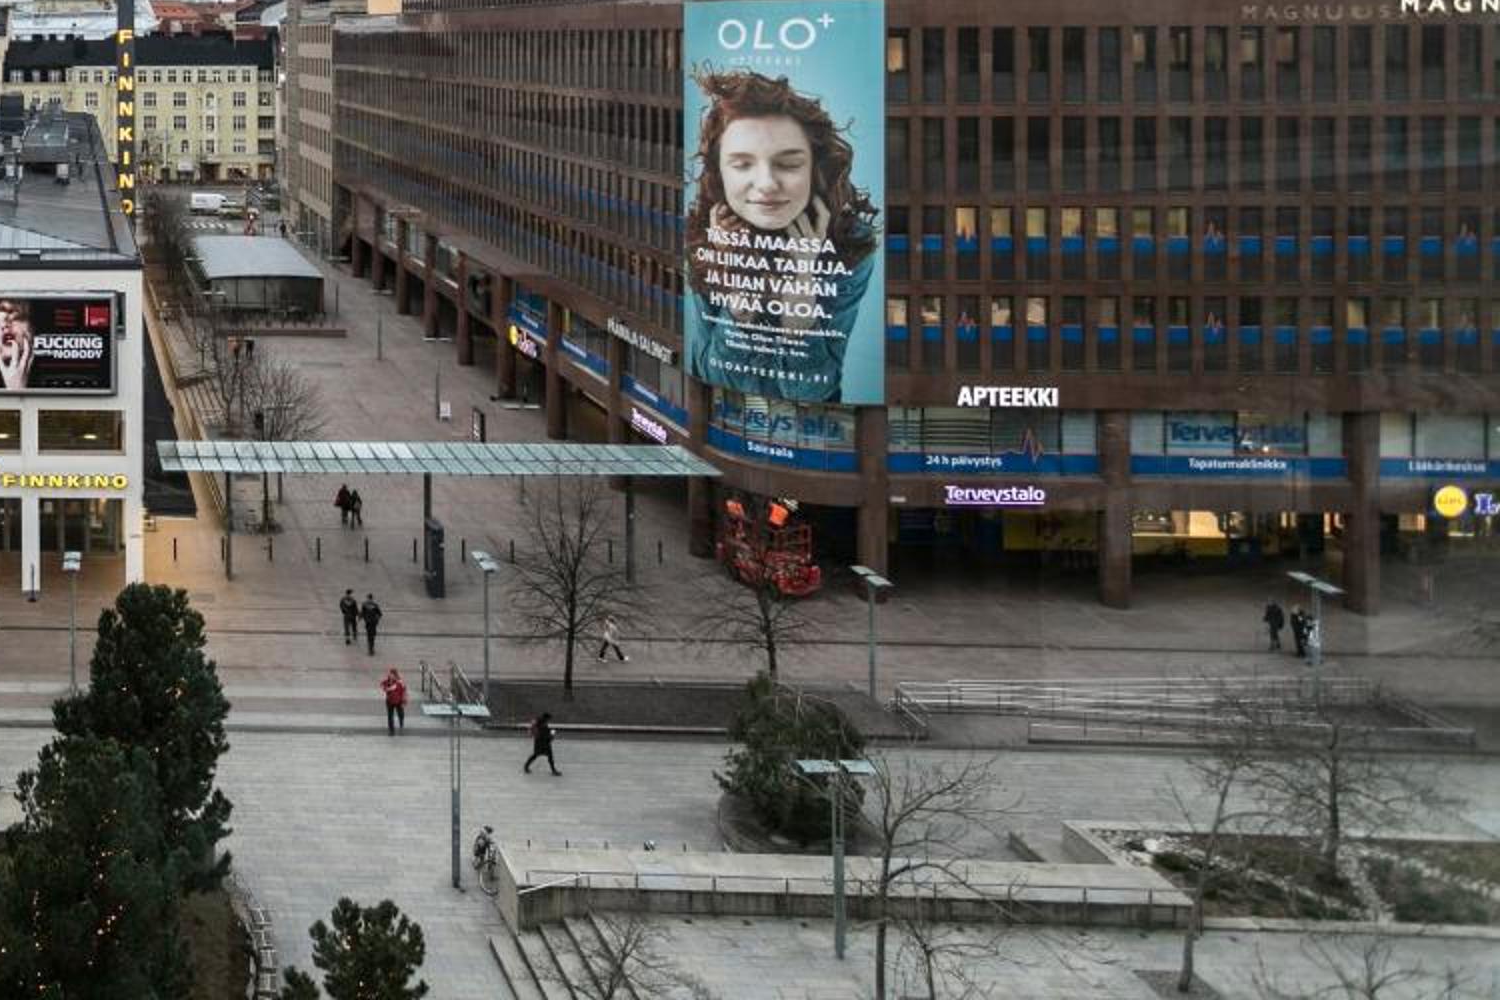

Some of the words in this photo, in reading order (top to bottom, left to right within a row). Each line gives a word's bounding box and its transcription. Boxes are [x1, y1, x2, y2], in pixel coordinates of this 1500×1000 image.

[118, 29, 134, 214] FINNKINO
[706, 225, 751, 248] TÄSSÄ
[754, 234, 836, 254] MAASSA
[697, 247, 714, 262] ON
[717, 251, 770, 271] LIIKAA
[774, 257, 853, 276] TABUJA.
[704, 270, 721, 285] JA
[723, 273, 765, 292] LIIAN
[769, 275, 837, 297] VÄHÄN
[710, 291, 763, 313] HYVÄÄ
[766, 300, 833, 319] OLOA.
[33, 336, 103, 349] FUCKING
[53, 349, 103, 359] NOBODY
[957, 385, 1059, 407] APTEEKKI
[925, 456, 940, 465] 24
[951, 455, 1002, 468] päivystys
[3, 473, 129, 489] FINNKINO
[944, 485, 1046, 504] Terveystalo
